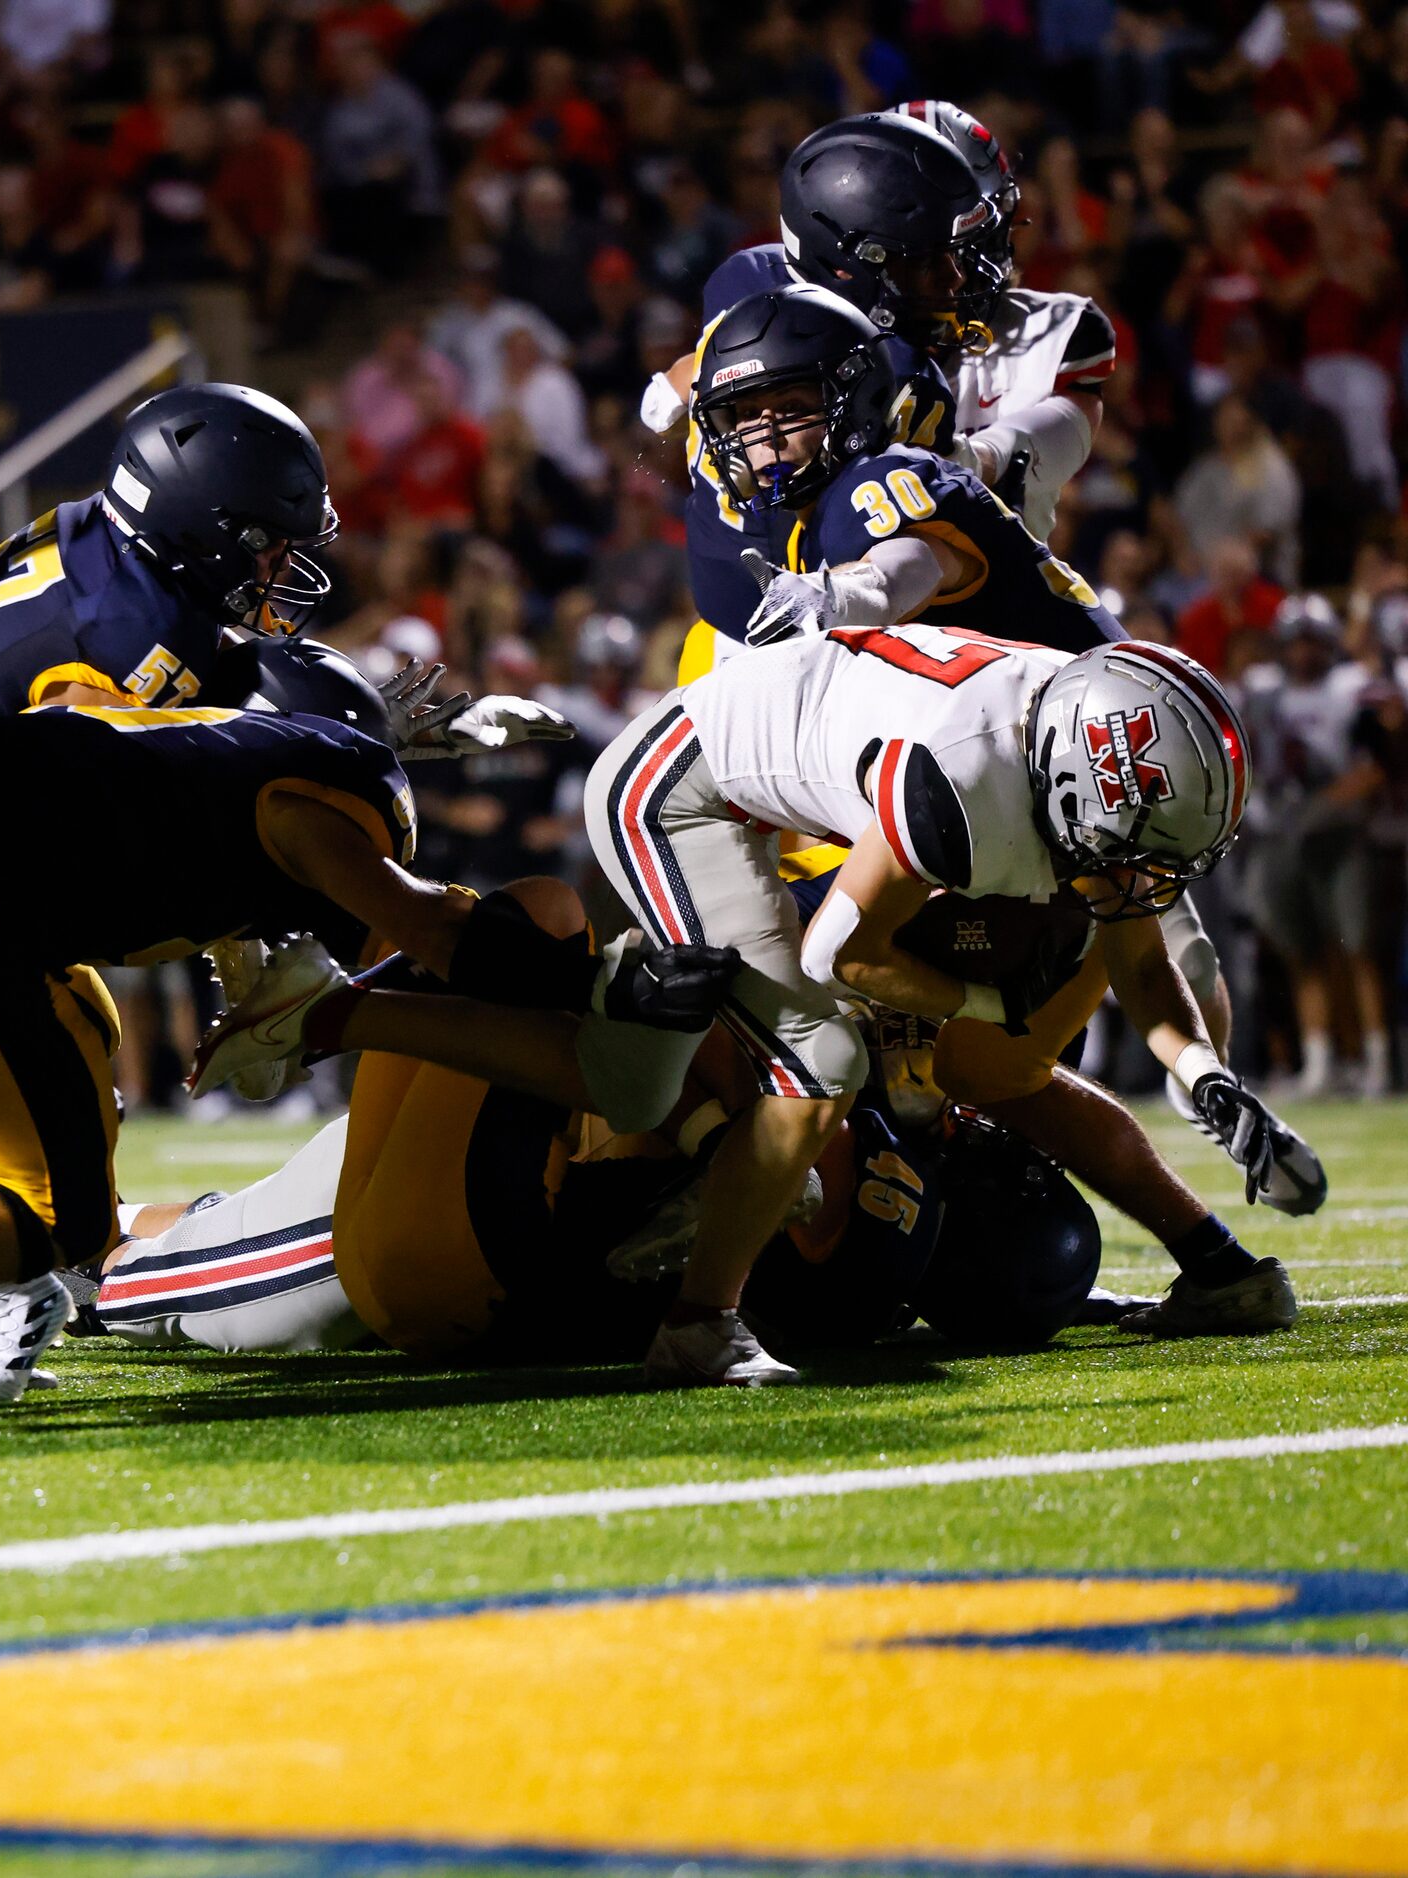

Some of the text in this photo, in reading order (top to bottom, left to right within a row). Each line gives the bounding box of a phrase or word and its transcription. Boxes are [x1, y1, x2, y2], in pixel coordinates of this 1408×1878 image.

[716, 362, 758, 384] Riddell
[850, 468, 937, 538] 30
[122, 643, 202, 709] 57
[1081, 704, 1176, 815] M
[1109, 712, 1142, 807] marcus
[857, 1150, 924, 1236] 45
